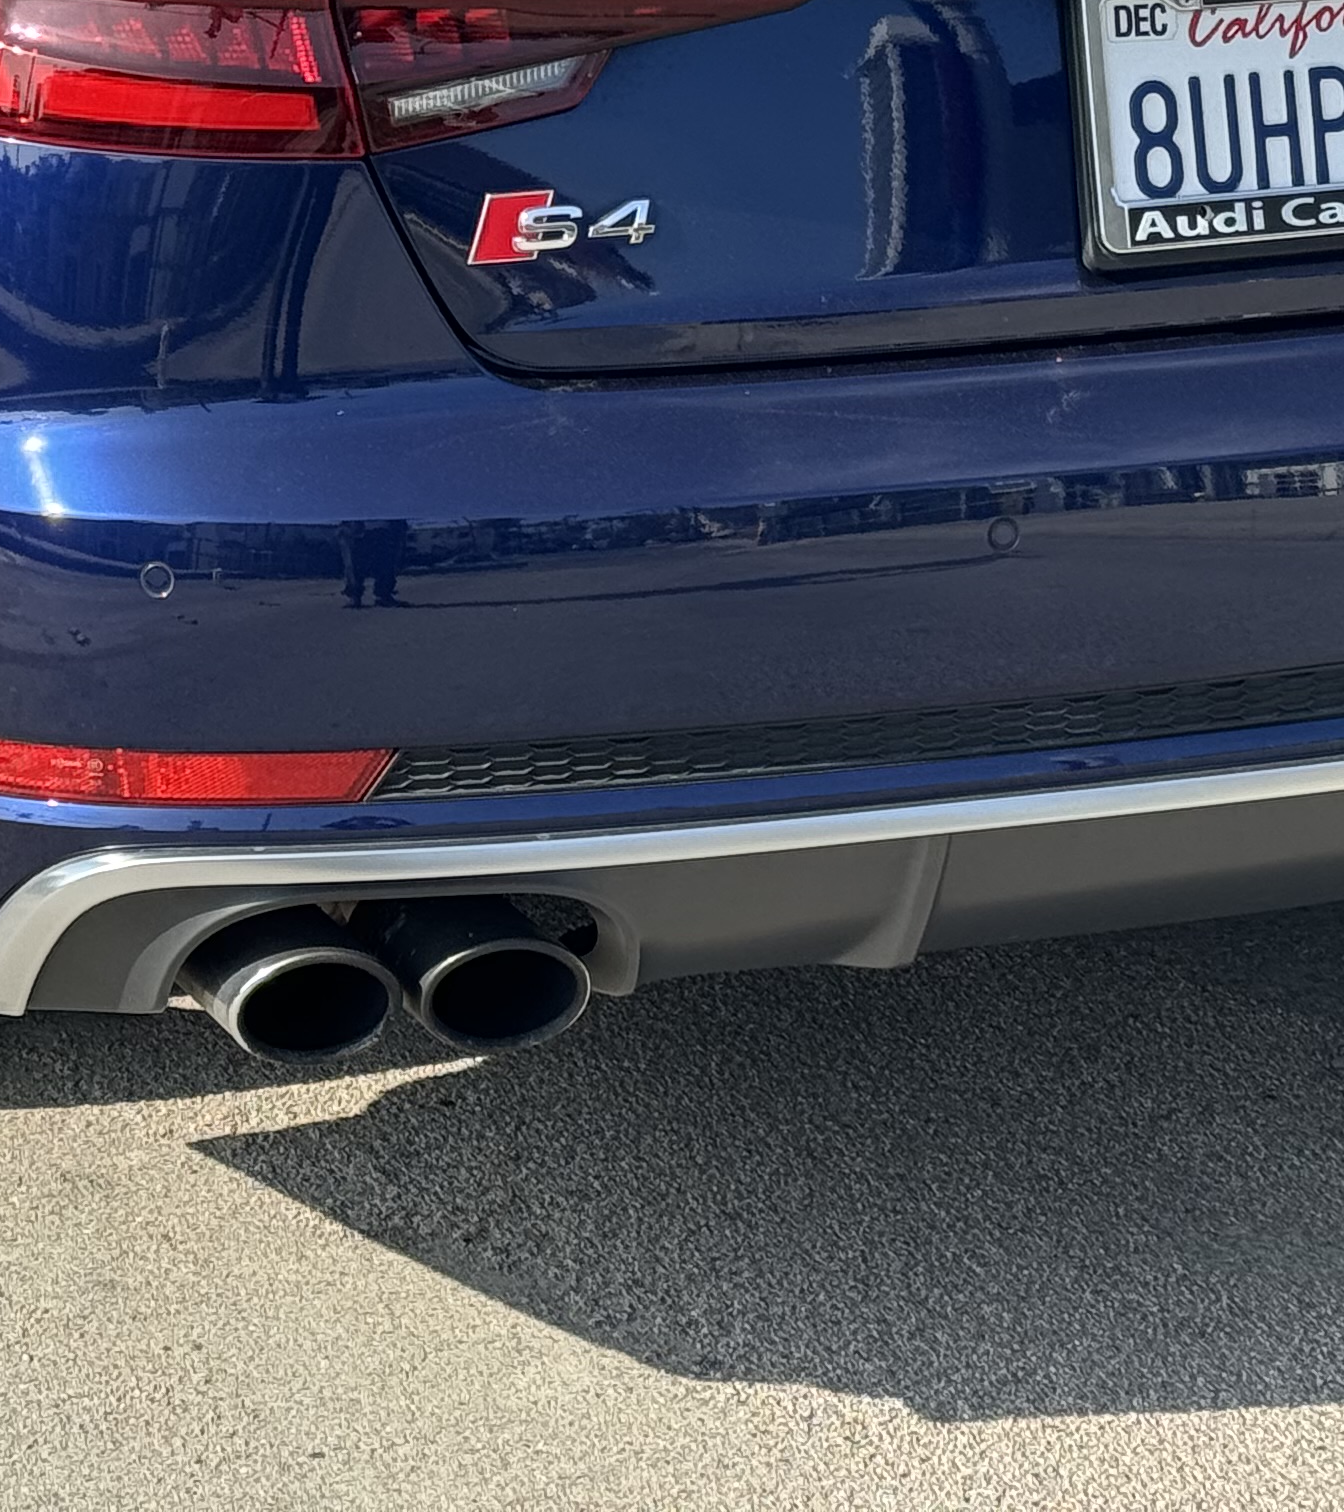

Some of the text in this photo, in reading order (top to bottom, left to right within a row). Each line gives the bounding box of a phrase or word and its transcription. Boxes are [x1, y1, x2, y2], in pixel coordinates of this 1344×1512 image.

[1114, 3, 1167, 38] DEC
[512, 199, 656, 254] S4
[1135, 200, 1265, 242] Audi
